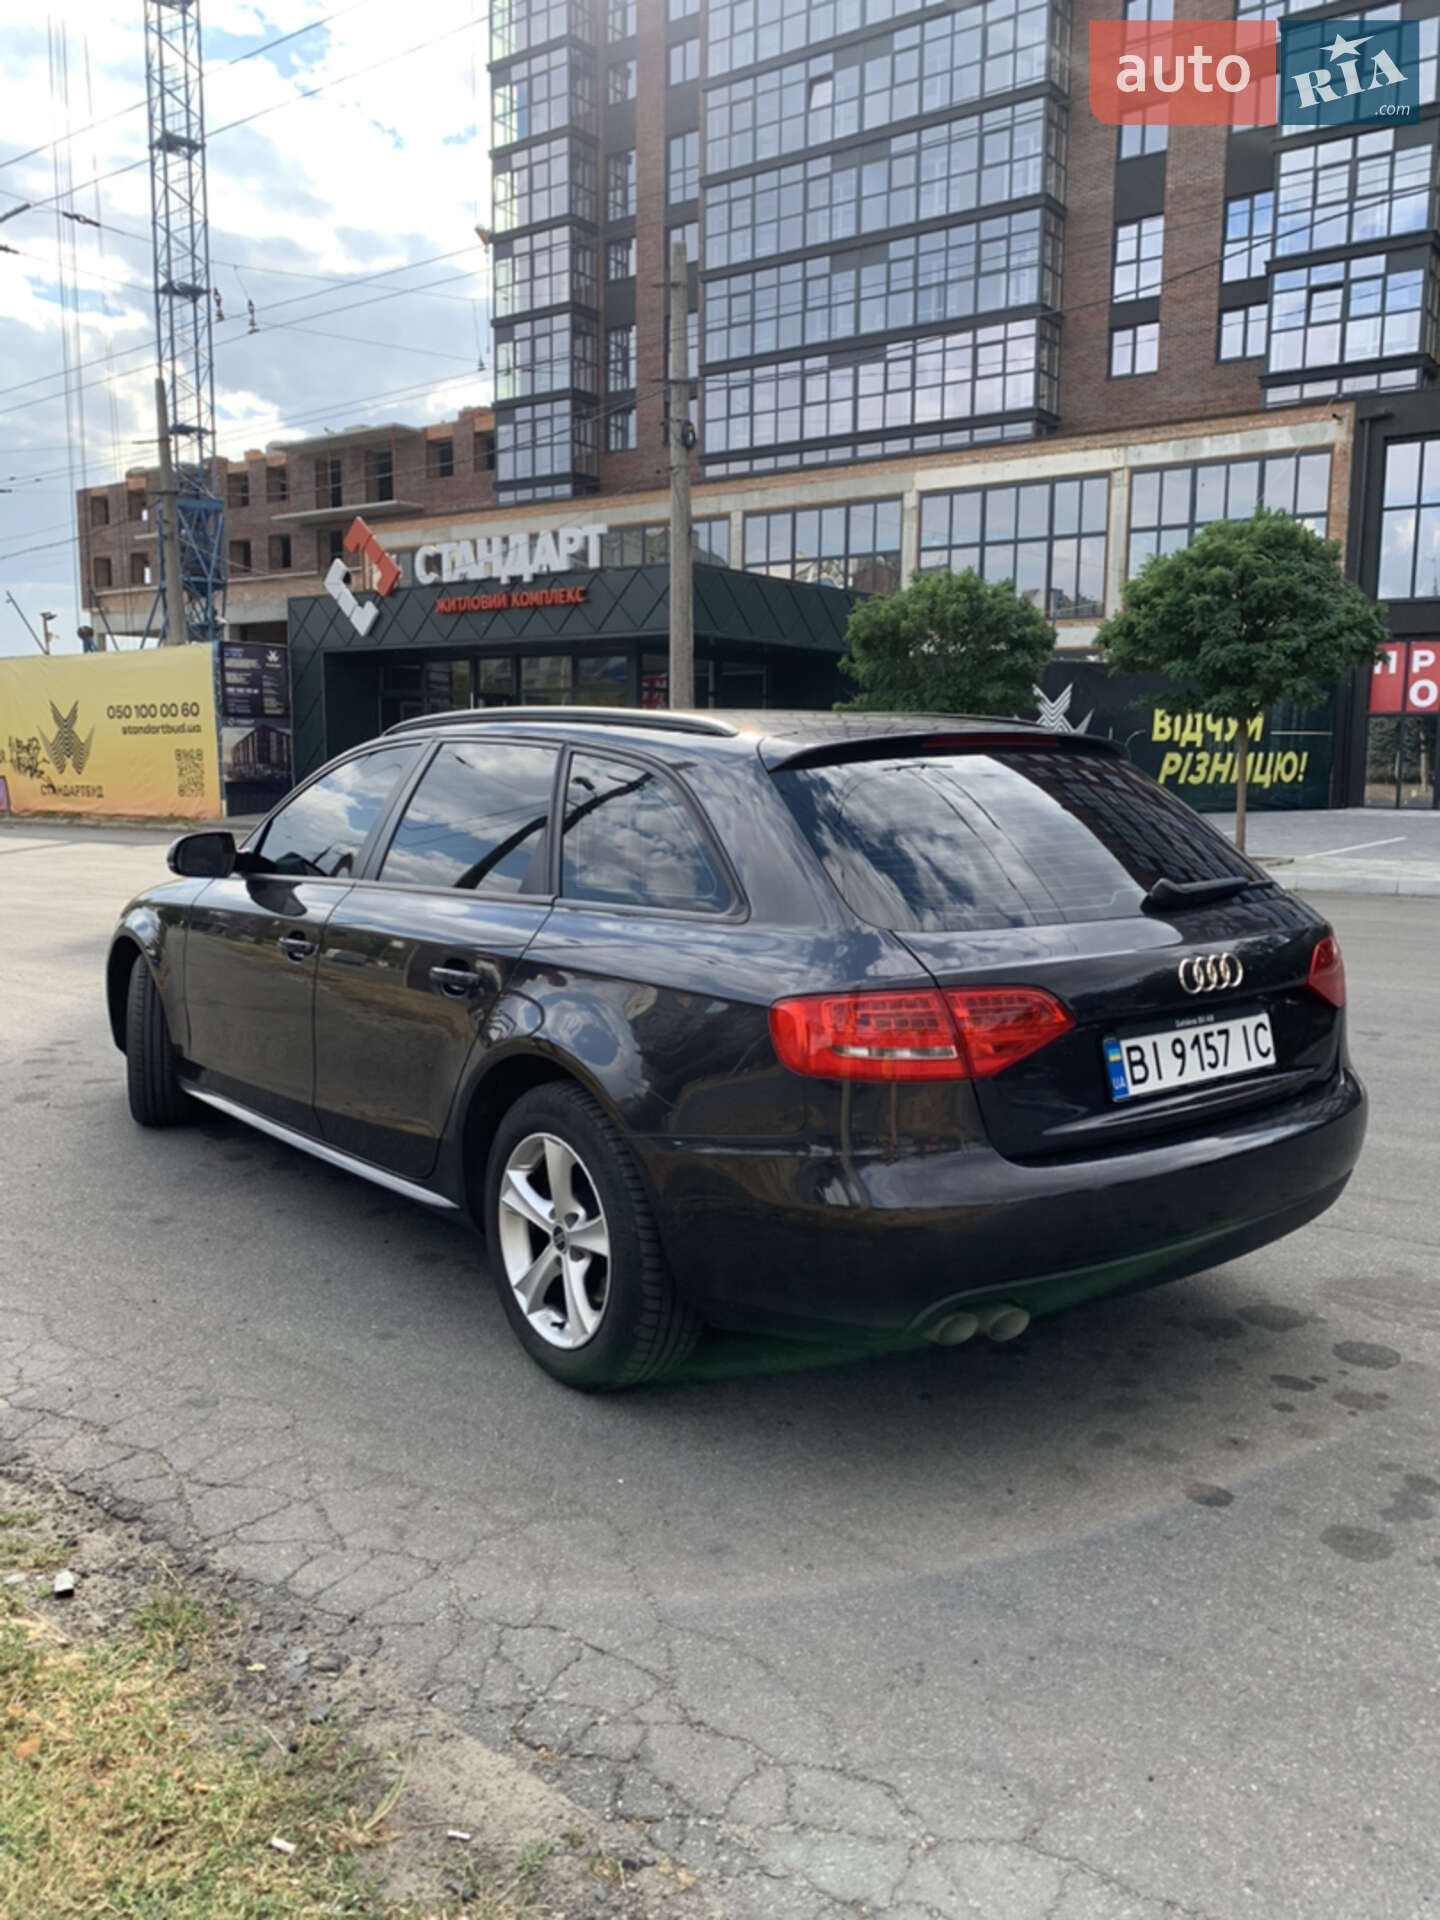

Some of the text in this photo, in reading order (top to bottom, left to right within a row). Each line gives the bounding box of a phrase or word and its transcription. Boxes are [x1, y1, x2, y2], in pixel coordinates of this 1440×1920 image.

[415, 523, 607, 585] СТАНДАРТ
[435, 586, 587, 614] ЖИТЛОВИЙ КОМПЛЕКС
[106, 701, 200, 719] 050 100 00 60
[1157, 751, 1308, 789] РІЗНИЦЮ!
[1125, 1021, 1272, 1086] BI 9157 IC
